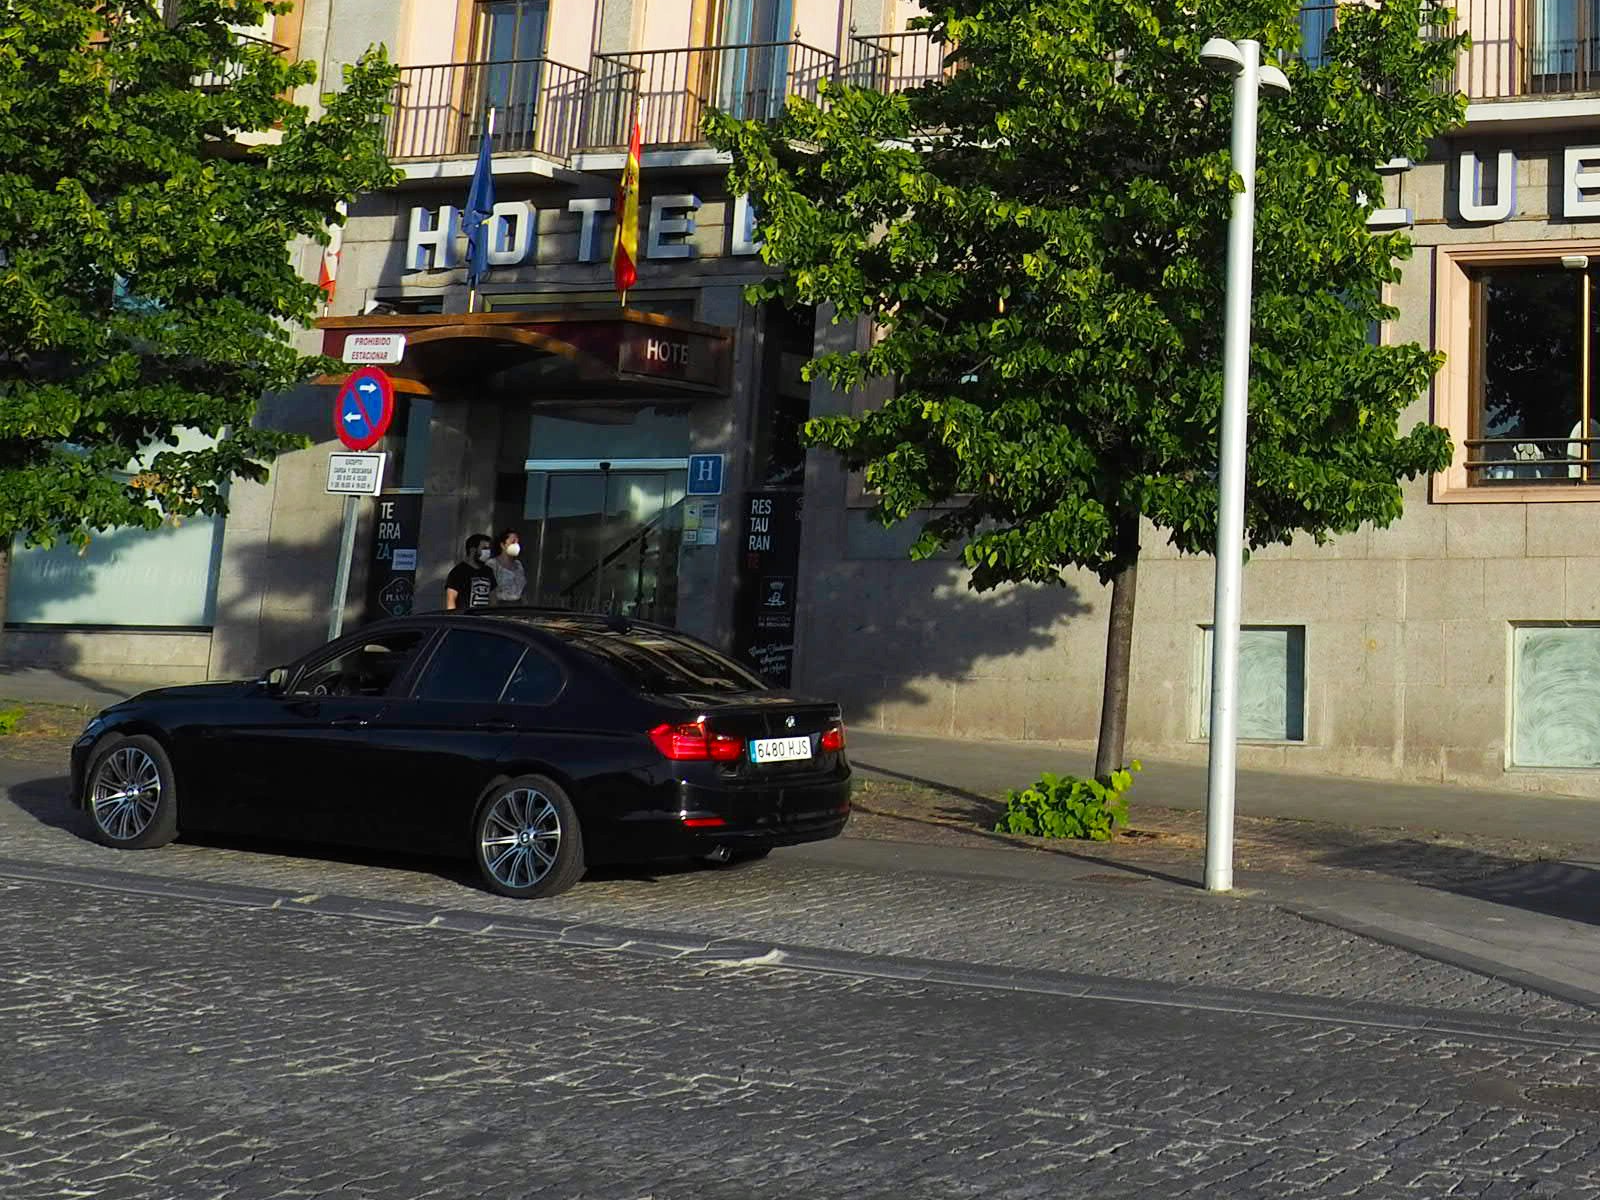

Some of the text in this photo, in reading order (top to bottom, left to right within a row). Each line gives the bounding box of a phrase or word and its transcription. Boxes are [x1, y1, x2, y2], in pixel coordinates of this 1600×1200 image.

[406, 193, 763, 271] HOTEL
[355, 337, 391, 346] PROHIBIDO
[351, 351, 388, 360] ESTACIONAR
[646, 337, 694, 367] HOTE
[698, 460, 714, 481] H
[381, 502, 395, 519] TE
[751, 499, 772, 514] RES
[378, 522, 400, 539] RRA
[750, 517, 769, 533] TAU
[748, 535, 770, 551] RAN
[757, 740, 808, 758] 6480 HJS
